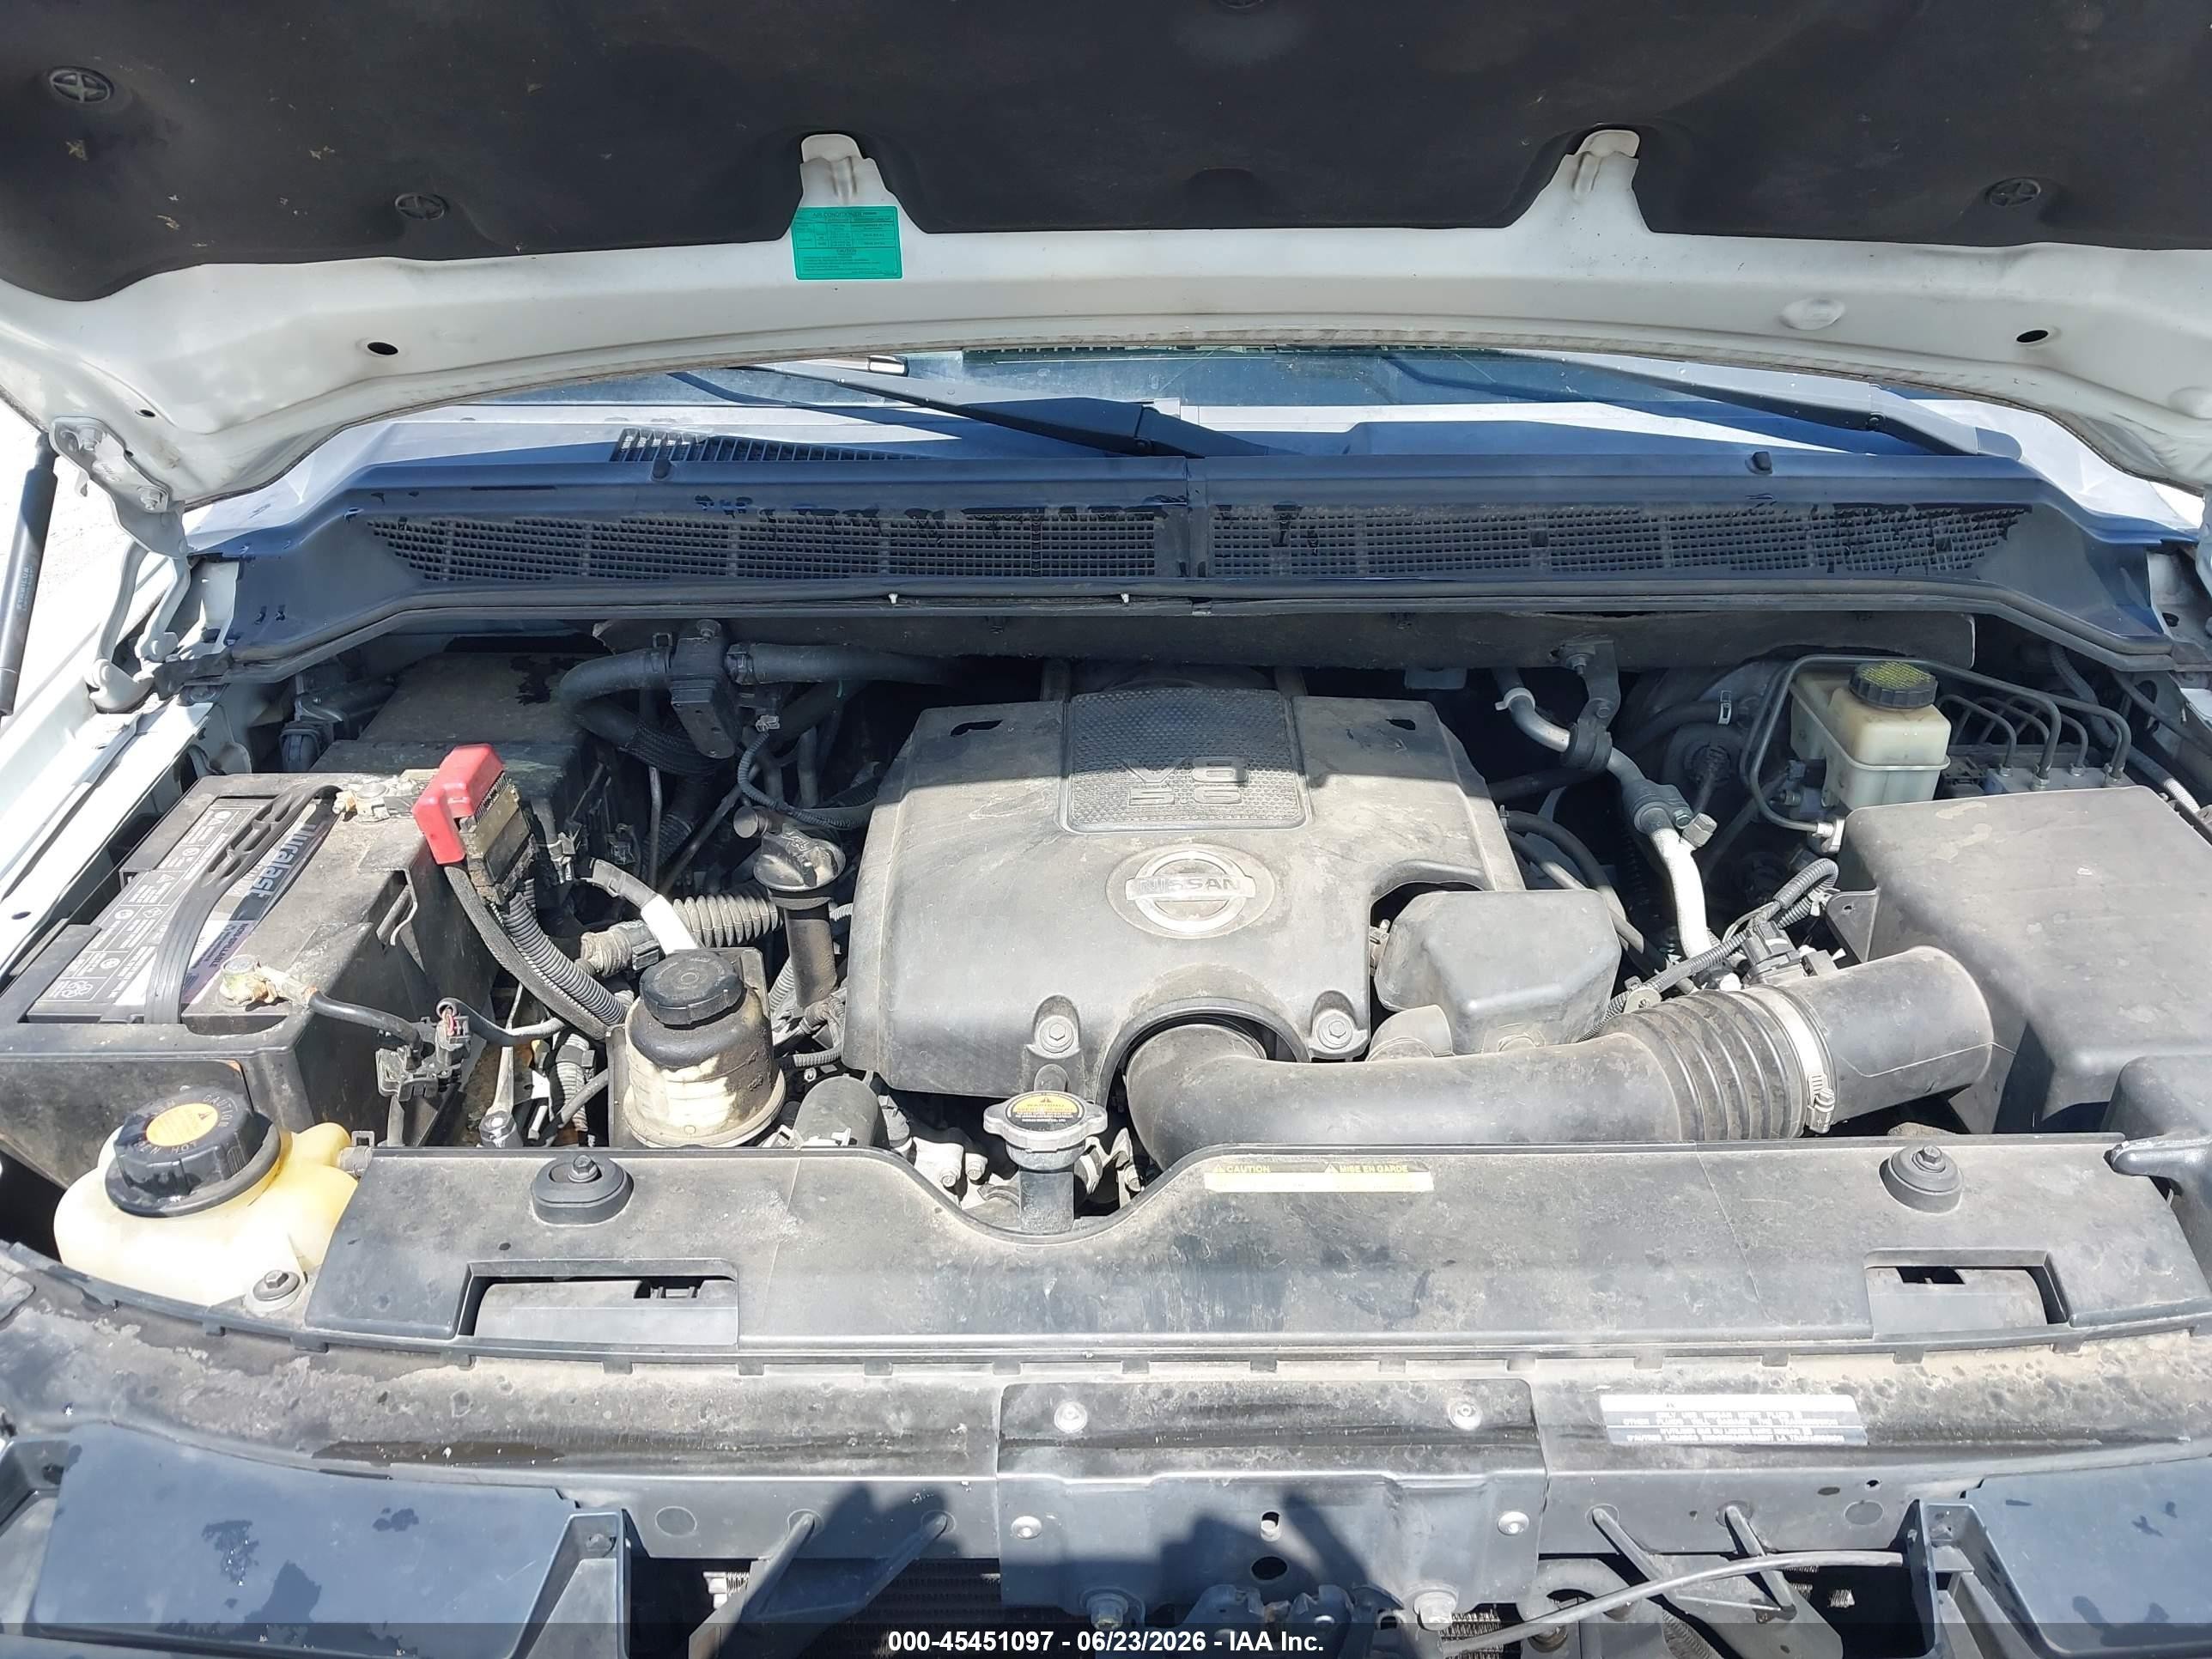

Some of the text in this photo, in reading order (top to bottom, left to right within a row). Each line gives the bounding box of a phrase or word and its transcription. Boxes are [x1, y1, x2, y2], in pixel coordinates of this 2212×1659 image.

[1122, 756, 1249, 783] V8
[1139, 877, 1239, 894] NISSAN
[203, 1094, 234, 1127] CAUTION
[171, 1140, 198, 1154] HOT
[1225, 1164, 1271, 1173] CAUTION
[1340, 1164, 1362, 1173] MISE
[1376, 1164, 1408, 1173] GARDE
